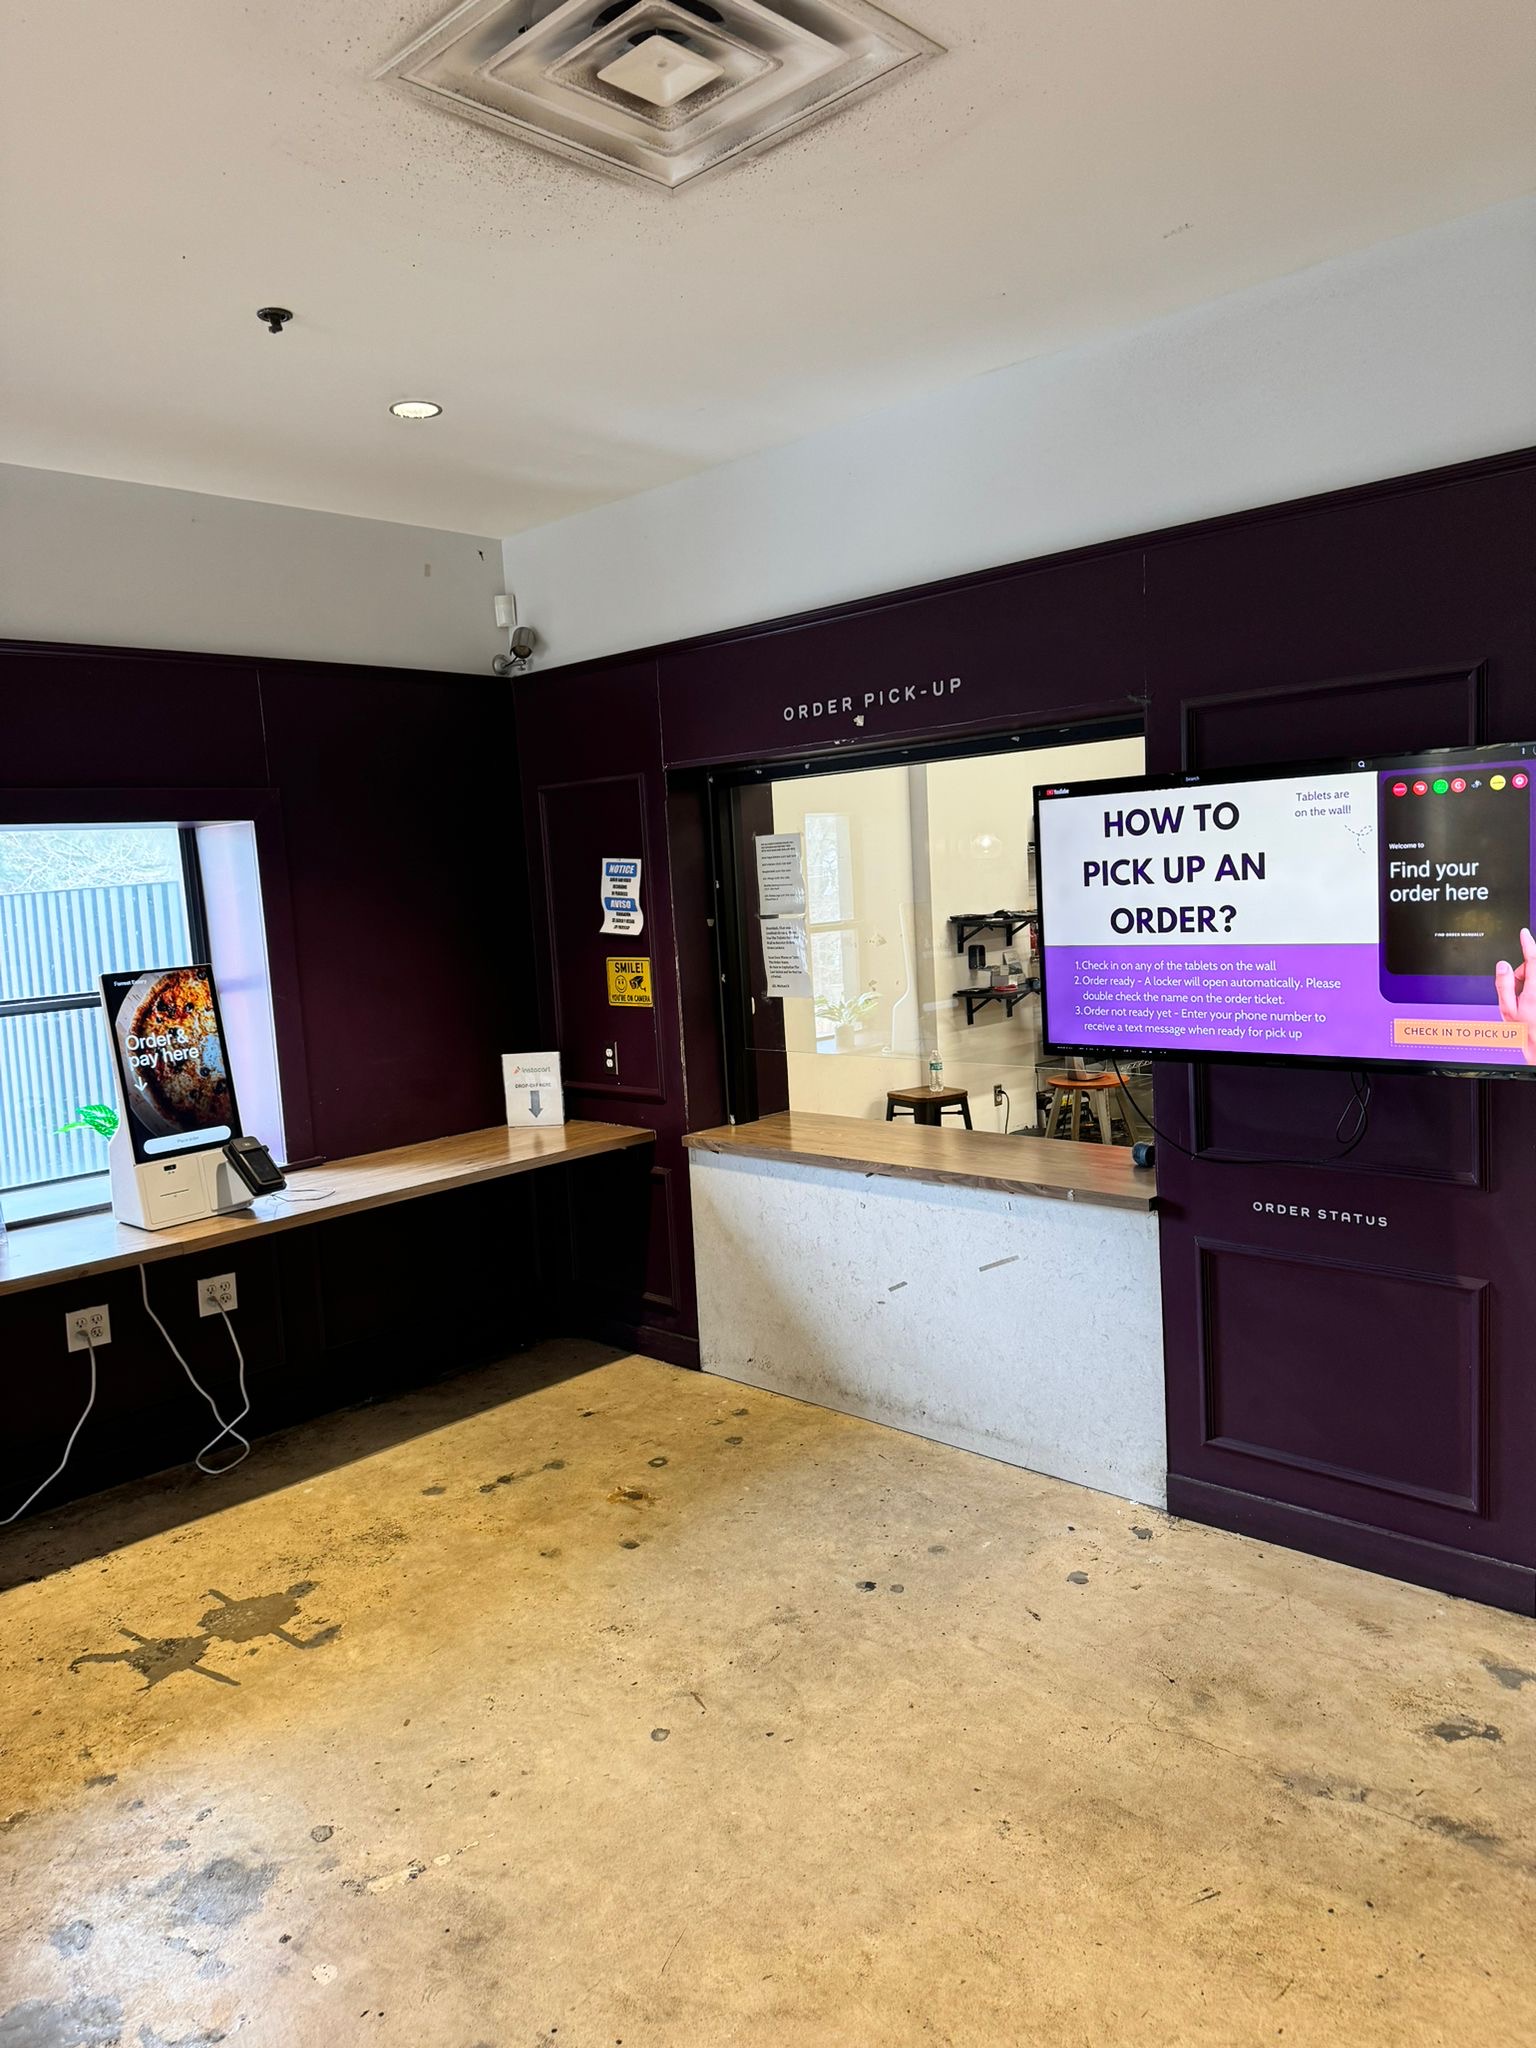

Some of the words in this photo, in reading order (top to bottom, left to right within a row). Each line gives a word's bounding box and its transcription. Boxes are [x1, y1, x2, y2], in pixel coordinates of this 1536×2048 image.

[783, 696, 852, 722] ORDER
[864, 677, 962, 708] PICK-UP
[1295, 790, 1332, 801] Tablets
[1333, 790, 1350, 799] are
[1294, 809, 1308, 818] on
[1310, 806, 1326, 816] the
[1328, 804, 1352, 815] wall!
[1103, 806, 1185, 838] HOW
[1193, 801, 1240, 832] TO
[1389, 842, 1417, 850] Welcome
[608, 864, 635, 875] NOTICE
[1083, 858, 1155, 887] PICK
[1163, 855, 1206, 884] UP
[1214, 852, 1266, 882] AN
[1389, 859, 1431, 879] Find
[1435, 862, 1480, 882] your
[1389, 884, 1441, 902] order
[1445, 883, 1489, 901] here
[610, 899, 631, 909] AVISO
[1110, 904, 1237, 934] ORDER?
[614, 962, 644, 974] SMILE!
[1110, 961, 1119, 971] in
[1120, 962, 1133, 971] on
[1135, 962, 1152, 973] any
[1154, 960, 1165, 971] of
[1166, 960, 1183, 971] the
[1184, 960, 1218, 971] tablets
[1220, 962, 1234, 971] on
[1236, 960, 1253, 971] the
[1255, 960, 1277, 971] wall
[1110, 976, 1136, 988] ready
[1144, 976, 1152, 986] A
[1153, 976, 1182, 987] locker
[1183, 976, 1200, 987] will
[1202, 980, 1228, 990] open
[1230, 977, 1304, 991] automatically.
[1306, 977, 1342, 989] Please
[634, 995, 651, 1003] CAMERA
[1082, 991, 1114, 1001] double
[1115, 991, 1142, 1002] check
[1143, 992, 1159, 1002] the
[1161, 994, 1188, 1003] name
[1190, 994, 1204, 1003] on
[1206, 993, 1223, 1003] the
[1224, 993, 1252, 1004] order
[1254, 994, 1286, 1005] ticket.
[1111, 1007, 1127, 1017] not
[1128, 1008, 1155, 1020] ready
[1156, 1009, 1173, 1020] yet
[1181, 1009, 1208, 1019] Enter
[1209, 1011, 1233, 1022] your
[1234, 1010, 1268, 1022] phone
[1270, 1011, 1312, 1022] number
[1314, 1013, 1327, 1023] to
[125, 1032, 173, 1051] Order
[176, 1027, 188, 1043] &
[1084, 1022, 1116, 1032] receive
[1117, 1024, 1123, 1032] a
[1124, 1023, 1143, 1033] text
[1145, 1025, 1186, 1036] message
[1188, 1025, 1215, 1035] when
[1217, 1026, 1246, 1039] ready
[1248, 1026, 1263, 1037] for
[1265, 1028, 1286, 1040] pick
[1288, 1030, 1303, 1041] up
[1404, 1026, 1439, 1037] CHECK
[1442, 1028, 1453, 1037] IN
[1456, 1028, 1472, 1038] TO
[1474, 1029, 1498, 1039] PICK
[1502, 1030, 1518, 1040] UP
[128, 1051, 159, 1072] pay
[162, 1045, 200, 1064] here
[1252, 1201, 1310, 1218] ORDER
[1317, 1209, 1388, 1228] STATUS
